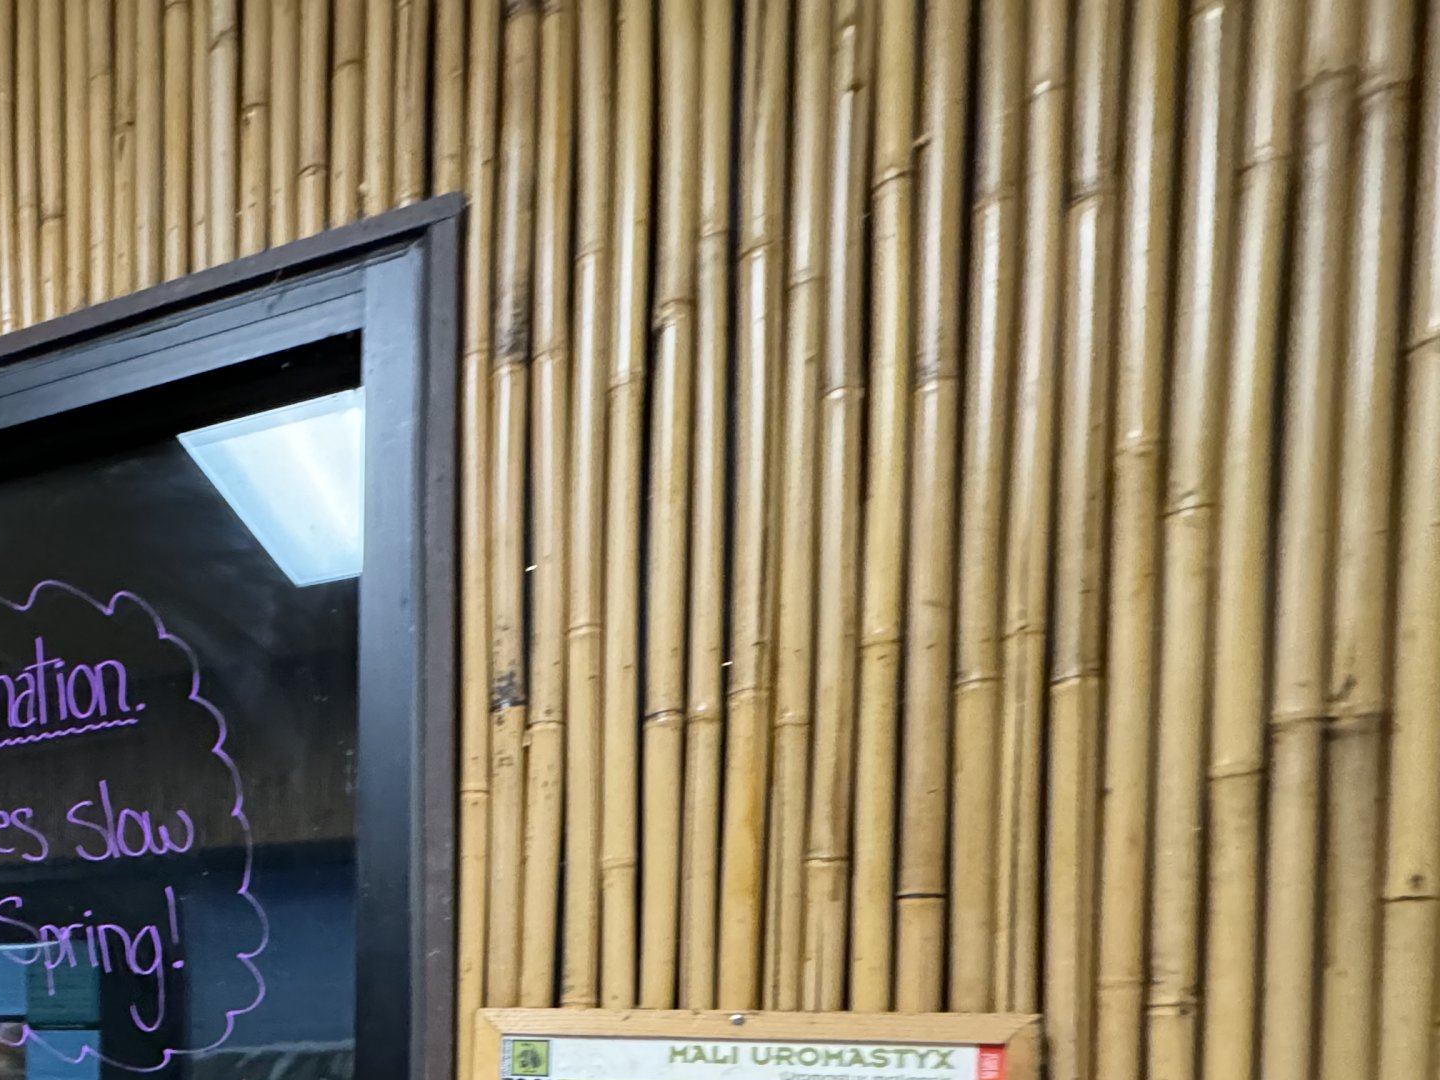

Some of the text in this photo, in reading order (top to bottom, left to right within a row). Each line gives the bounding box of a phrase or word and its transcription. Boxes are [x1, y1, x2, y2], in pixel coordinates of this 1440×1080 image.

[67, 780, 194, 862] slow
[668, 1045, 738, 1065] MALI
[751, 1046, 955, 1070] UROMASTYX
